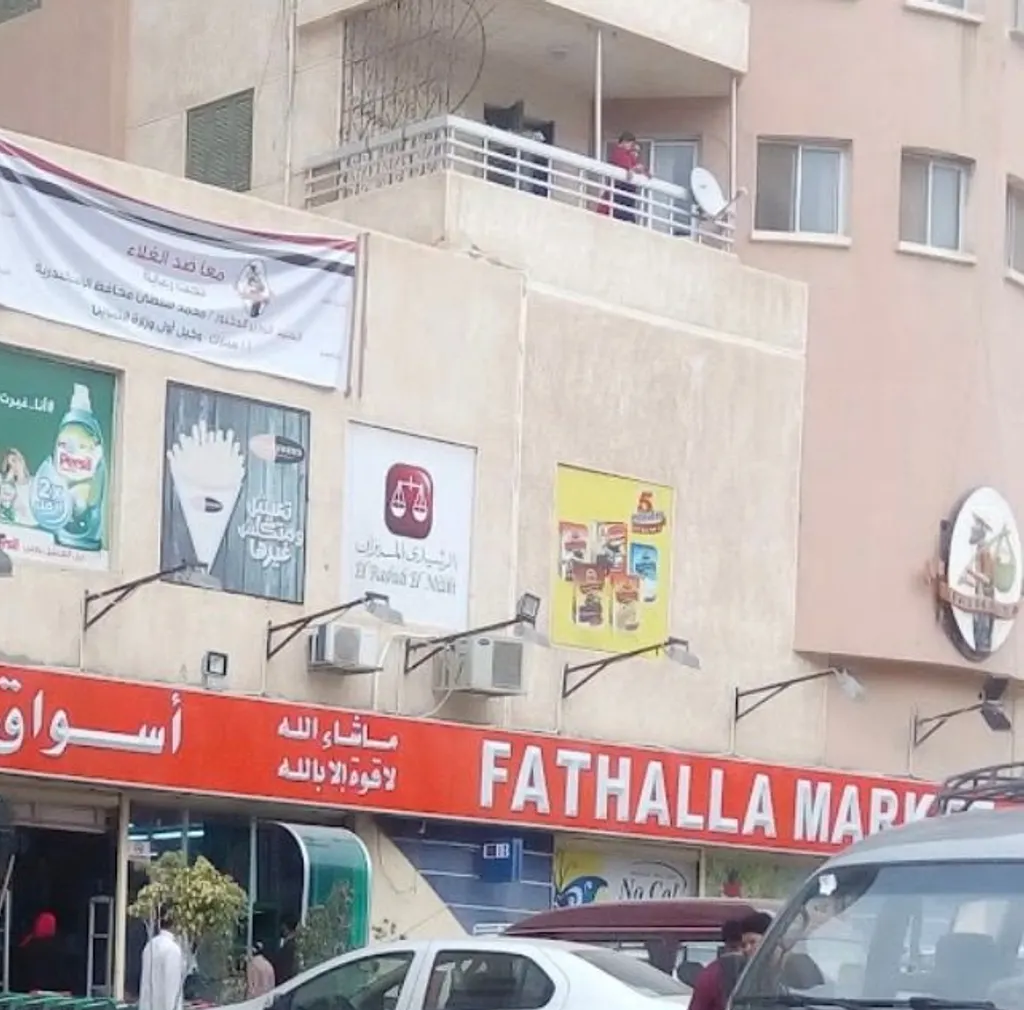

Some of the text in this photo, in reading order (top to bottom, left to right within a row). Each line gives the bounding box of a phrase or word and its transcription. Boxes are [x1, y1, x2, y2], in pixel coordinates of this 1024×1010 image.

[277, 716, 318, 740] الله
[277, 757, 325, 792] بالله
[479, 739, 995, 843] FATHALLA MARK
